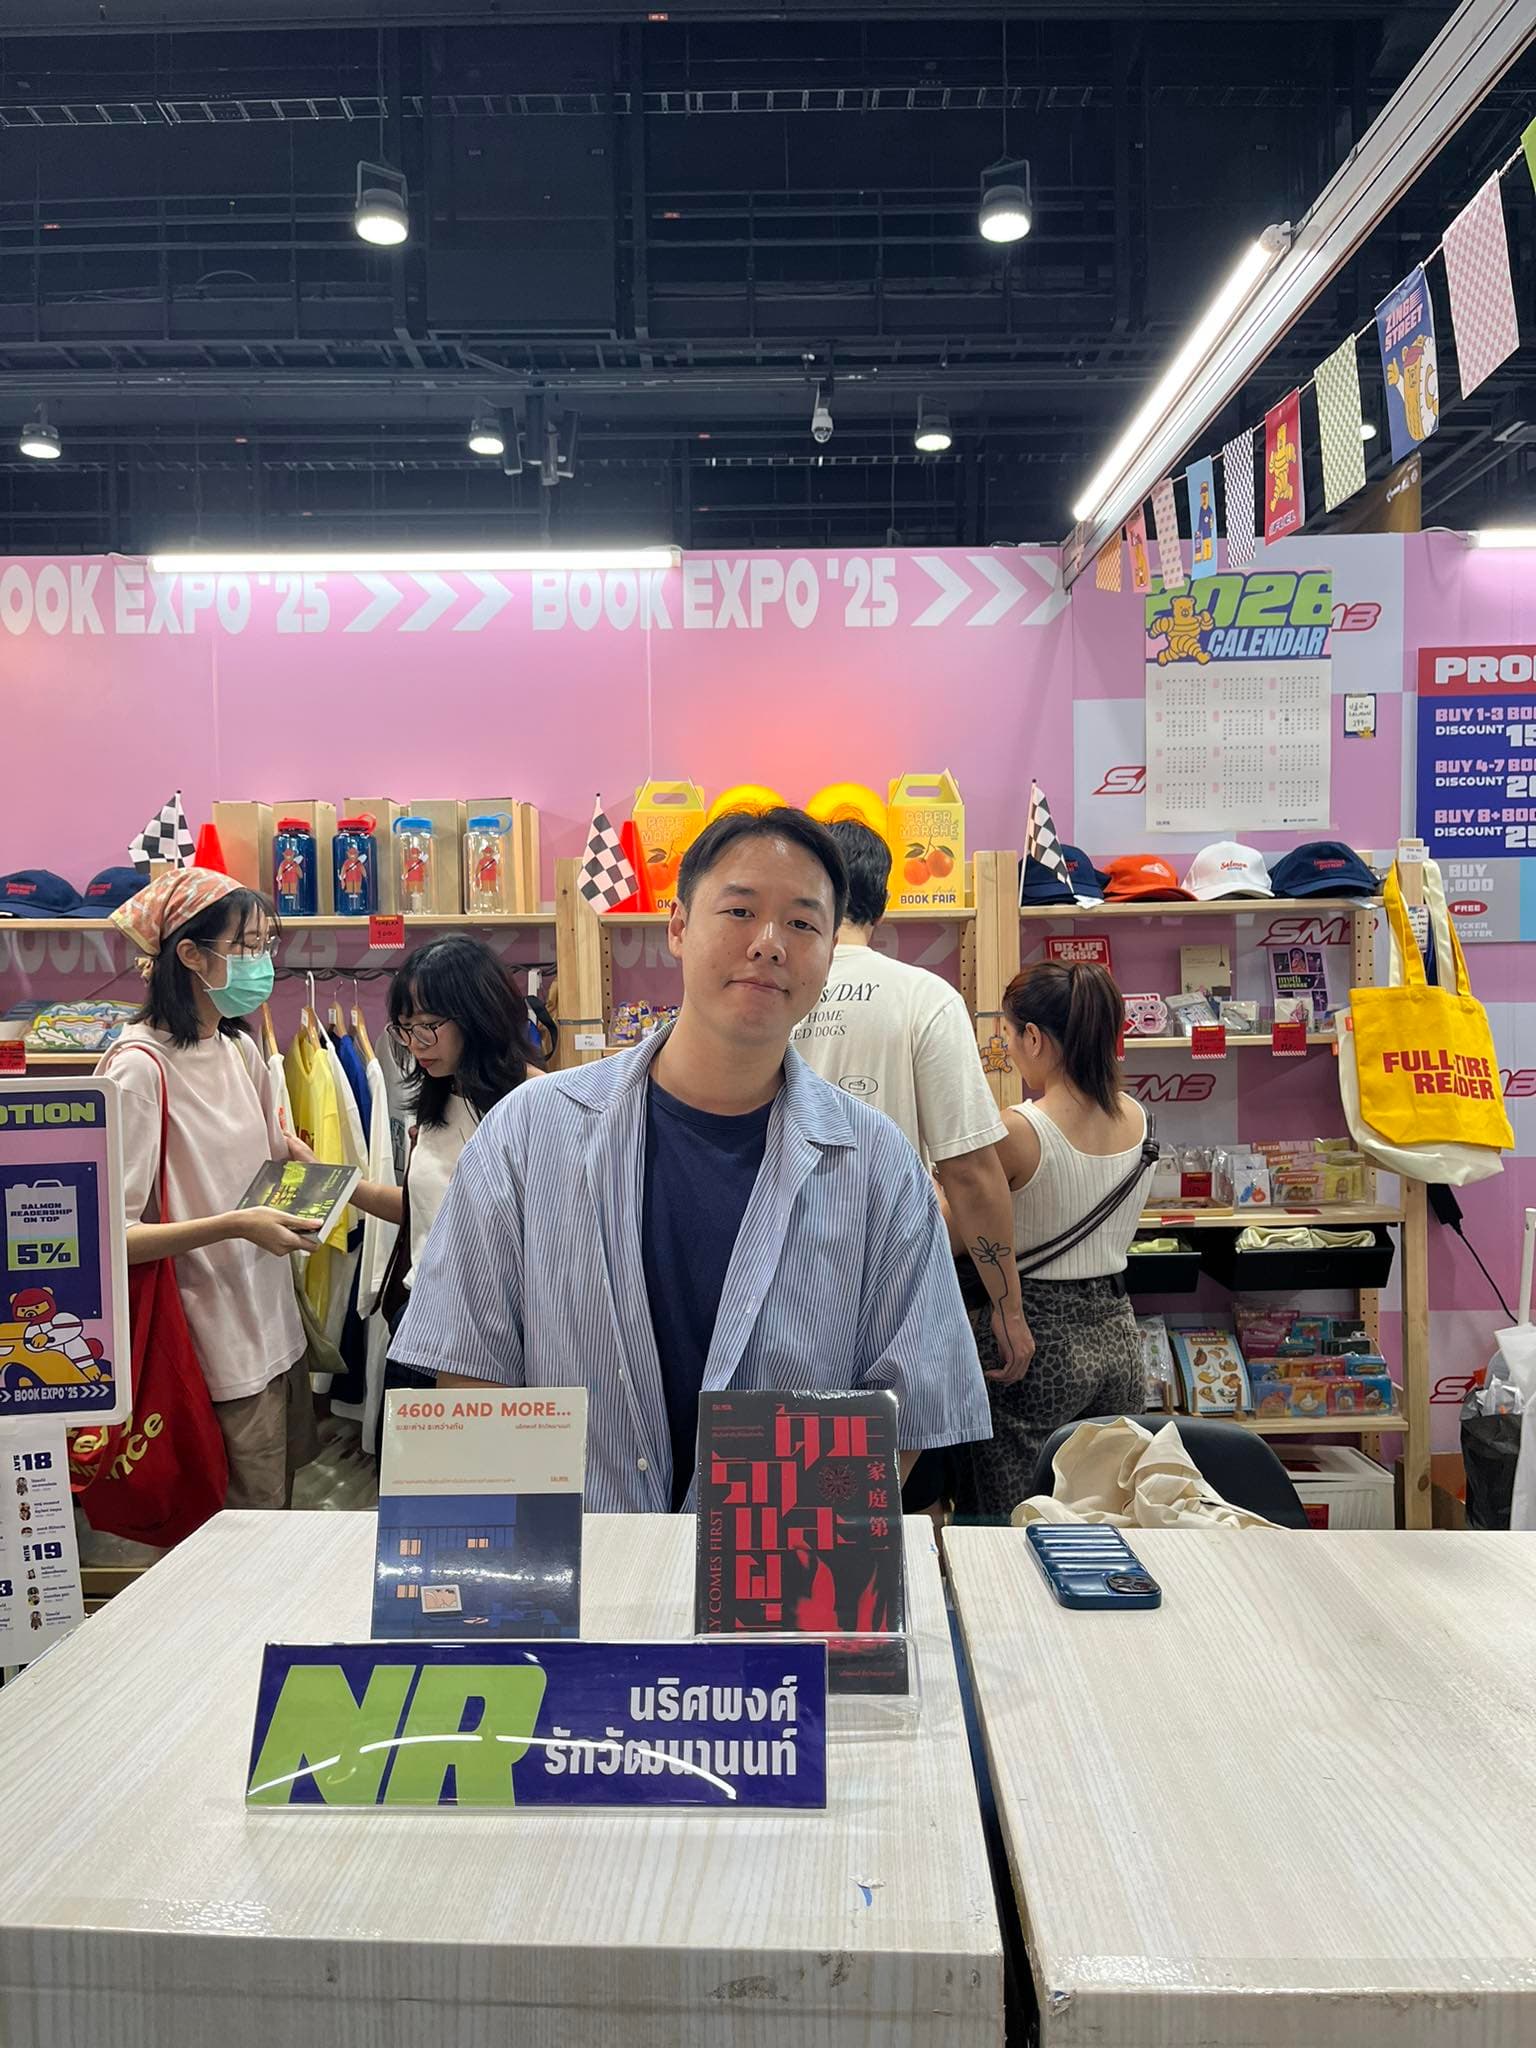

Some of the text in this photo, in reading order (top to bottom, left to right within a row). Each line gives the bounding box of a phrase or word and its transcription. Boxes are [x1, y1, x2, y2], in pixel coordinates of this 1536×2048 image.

[115, 565, 250, 634] EXPO
[258, 573, 330, 633] '25
[532, 556, 899, 631] BOOK EXPO '25
[1146, 572, 1332, 627] 2026
[1208, 627, 1325, 657] CALENDAR
[1435, 654, 1536, 684] PRO
[1435, 706, 1536, 722] BUY 1-3 BO
[1435, 724, 1505, 735] DISCOUNT
[1435, 758, 1536, 773] BUY 4-7 BO
[1435, 776, 1504, 787] DISCOUNT
[905, 809, 952, 823] PAPER
[1435, 809, 1475, 823] BUY
[1434, 826, 1503, 837] DISCOUNT
[1449, 863, 1488, 877] BUY
[657, 899, 671, 909] OK
[901, 893, 956, 904] BOOK FAIR
[1454, 904, 1481, 912] FREE
[1455, 922, 1488, 930] TICKER
[1054, 942, 1104, 953] BIZ-LIFE
[1060, 951, 1099, 960] CRISIS
[820, 983, 880, 1003] s/DAY
[807, 1009, 844, 1023] HOME
[790, 1025, 847, 1040] ED DOGS
[1383, 1049, 1454, 1073] FULL
[1414, 1072, 1495, 1100] READER
[10, 1209, 73, 1217] READERSHIP
[17, 1242, 71, 1265] 5%
[14, 1386, 79, 1402] BOOK EXPO '25
[396, 1402, 571, 1418] 4600 AND MORE...
[13, 1452, 52, 1471] SAT 18
[709, 1508, 723, 1551] FIRST
[32, 1542, 62, 1561] 19
[709, 1556, 723, 1613] COMES
[630, 1675, 798, 1722] นริศพงศ์
[249, 1664, 548, 1807] NR
